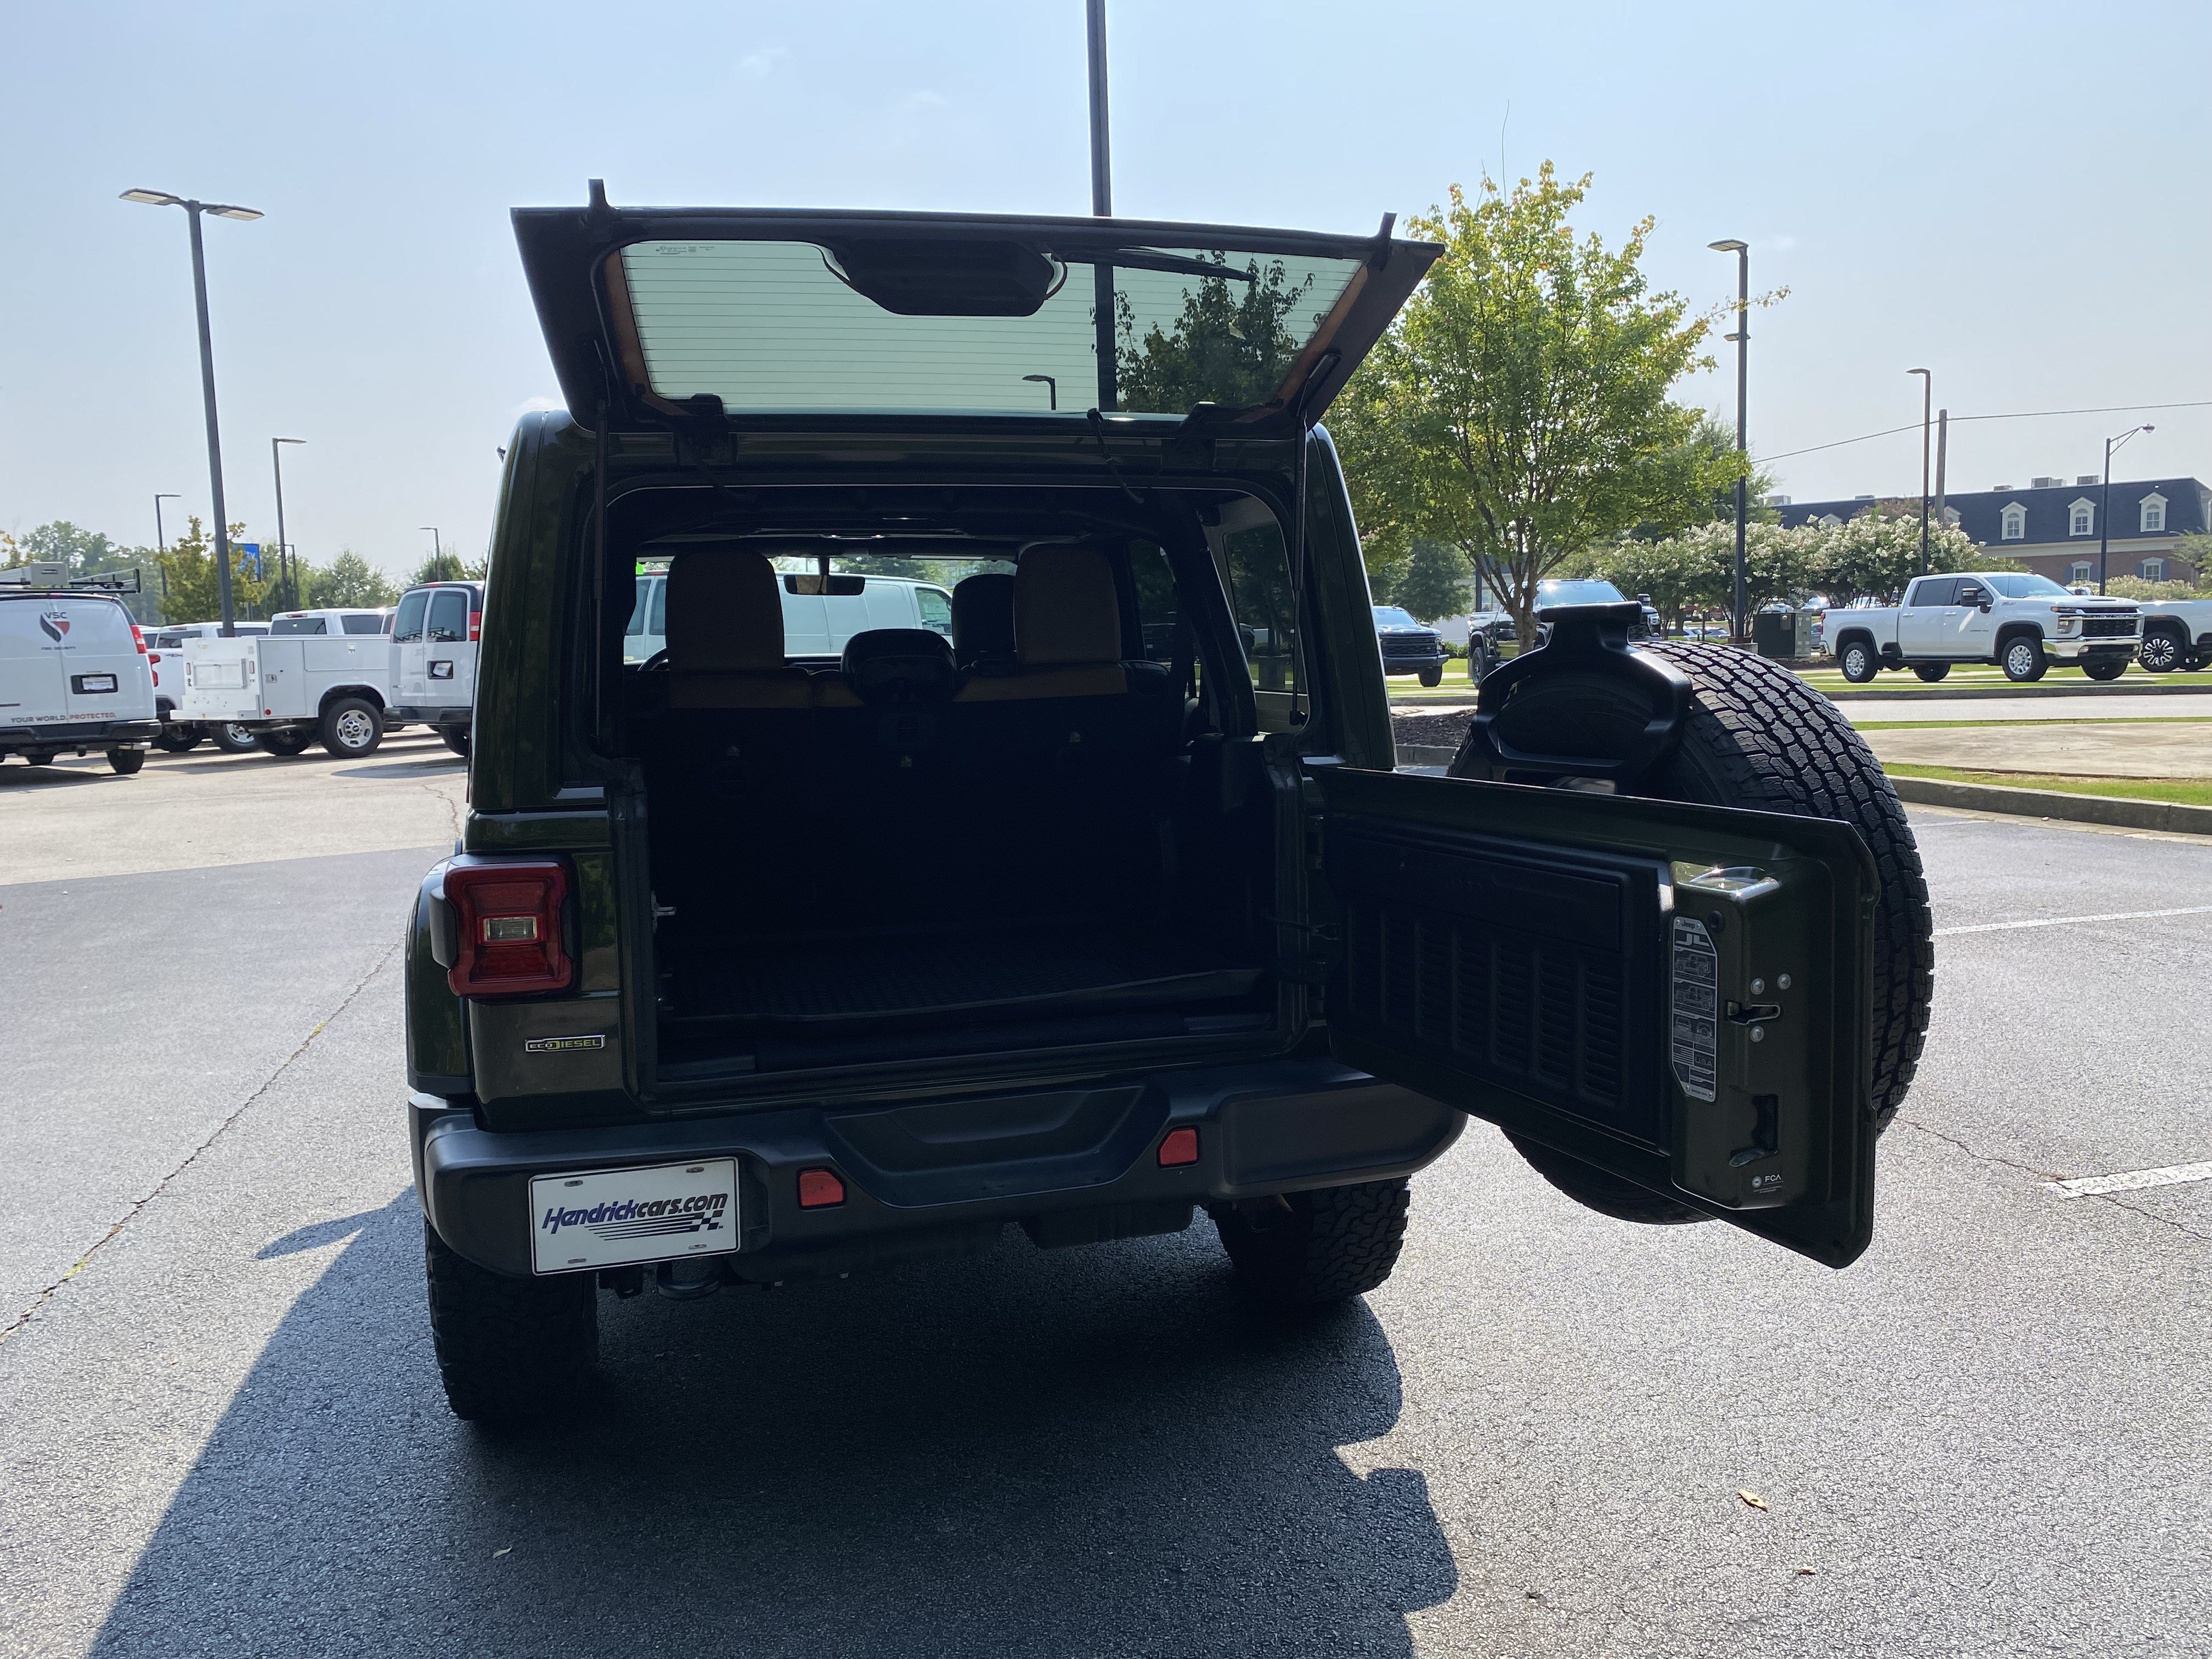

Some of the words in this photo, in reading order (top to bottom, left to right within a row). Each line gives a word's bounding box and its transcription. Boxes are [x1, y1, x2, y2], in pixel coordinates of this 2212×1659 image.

[1681, 920, 1695, 929] Jeep
[1675, 933, 1710, 947] JL
[1765, 1174, 1781, 1182] FCA
[541, 1193, 728, 1235] Hendrickcars.com
